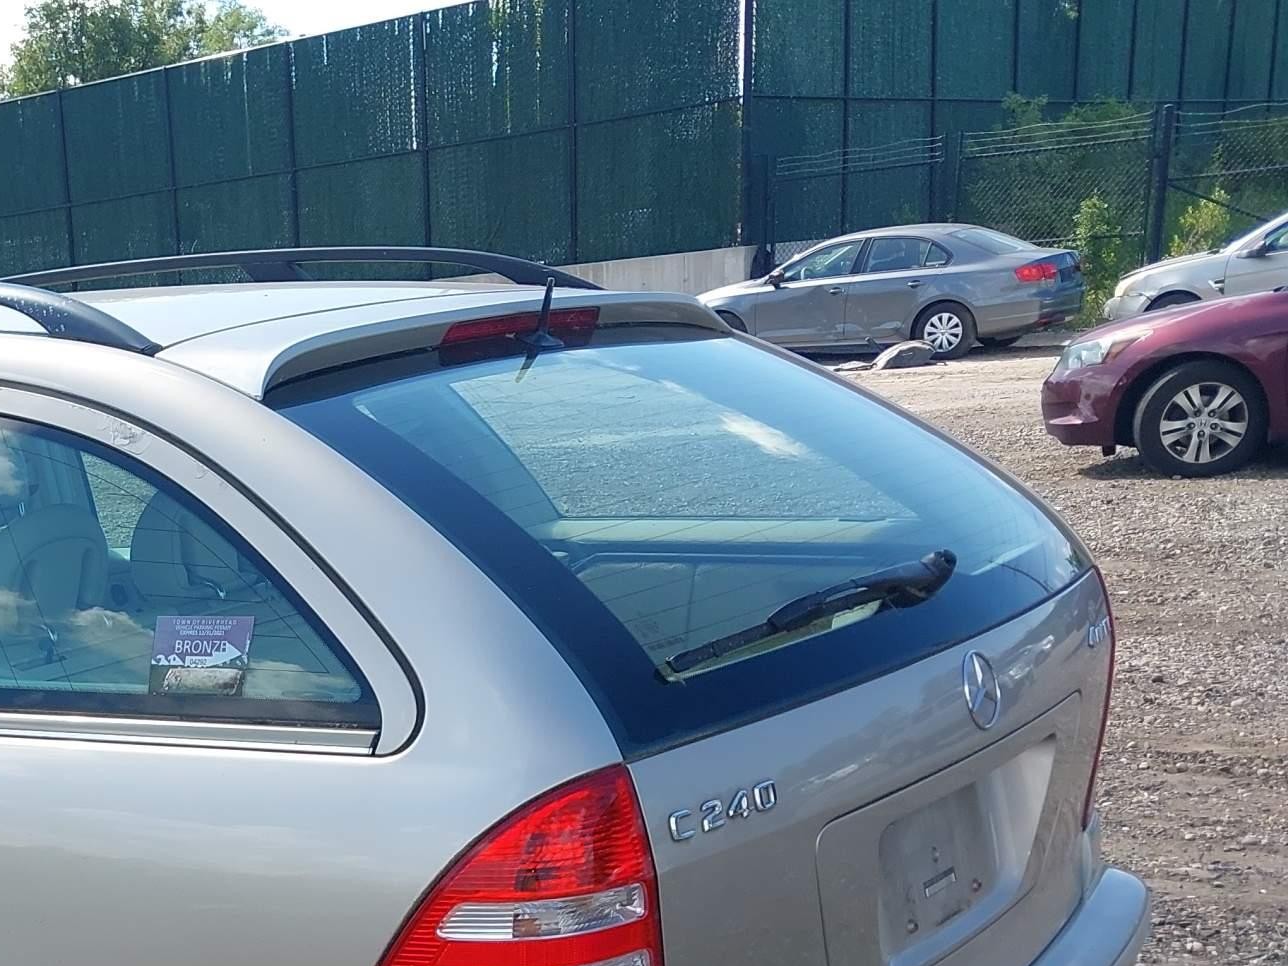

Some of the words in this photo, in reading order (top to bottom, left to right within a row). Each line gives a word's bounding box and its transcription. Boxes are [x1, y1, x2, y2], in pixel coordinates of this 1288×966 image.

[175, 640, 228, 654] BRONZE
[669, 809, 697, 842] C
[700, 779, 777, 833] 240
